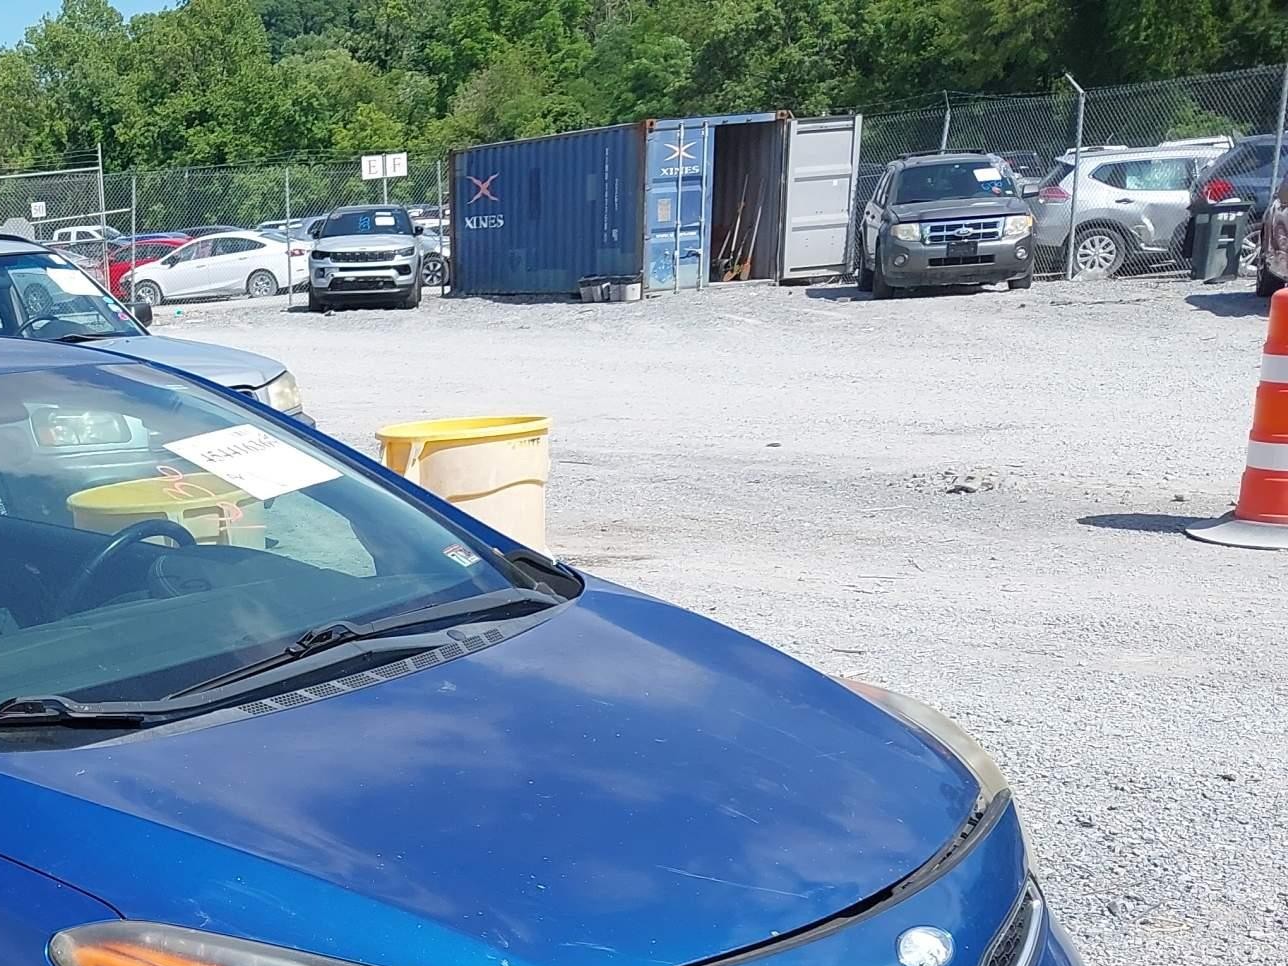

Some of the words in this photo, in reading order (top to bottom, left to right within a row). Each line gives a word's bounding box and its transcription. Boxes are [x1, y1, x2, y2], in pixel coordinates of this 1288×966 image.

[368, 159, 378, 175] E
[392, 157, 401, 173] F
[464, 214, 505, 229] XINES
